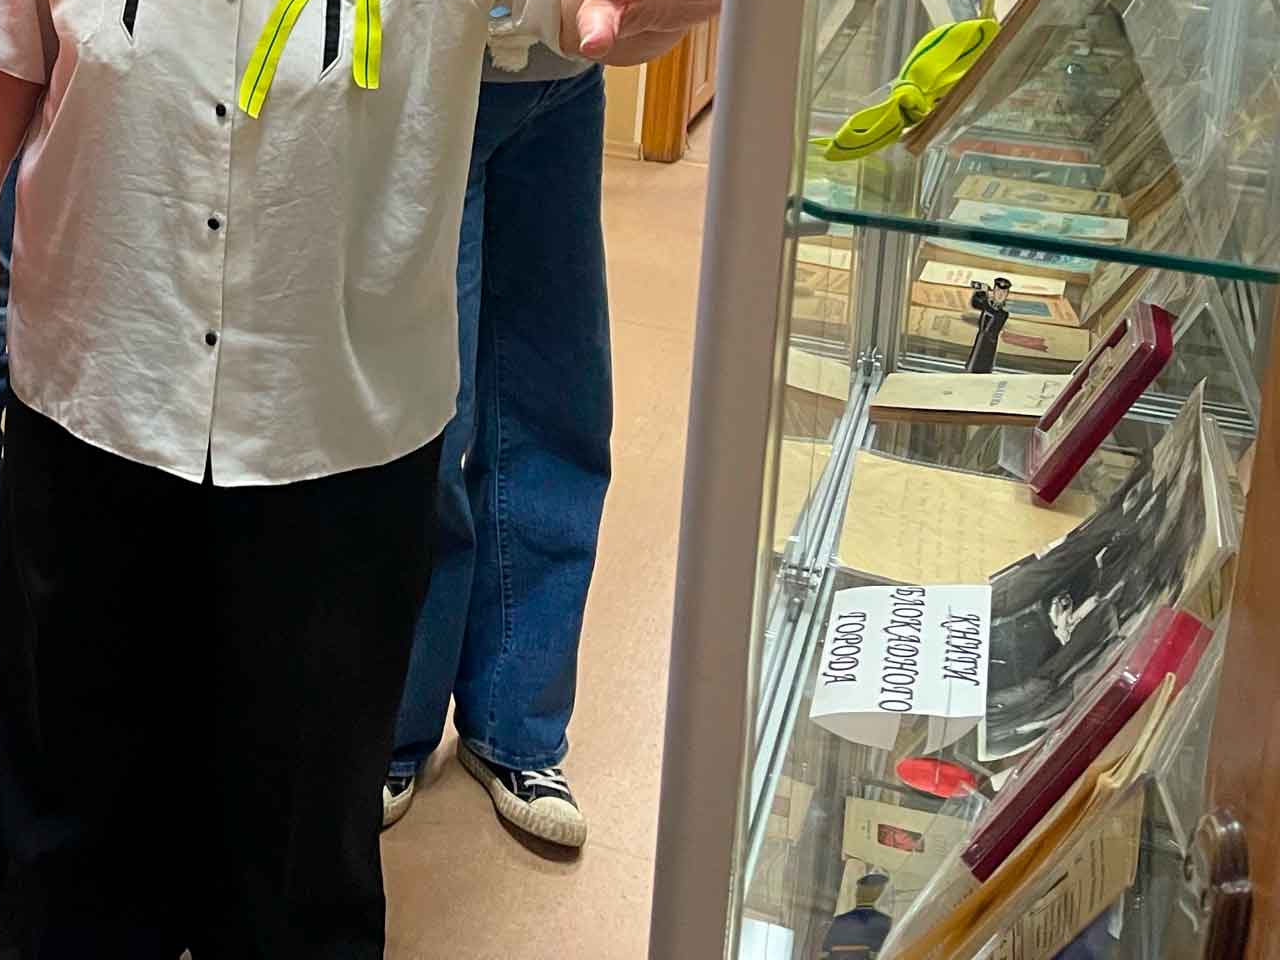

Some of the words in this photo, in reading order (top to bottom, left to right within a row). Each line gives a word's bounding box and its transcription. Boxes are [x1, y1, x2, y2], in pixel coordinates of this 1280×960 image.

[822, 611, 867, 685] ГОРОДА
[878, 587, 926, 712] БЛОКАДНОГО
[941, 614, 982, 686] КНИГИ
